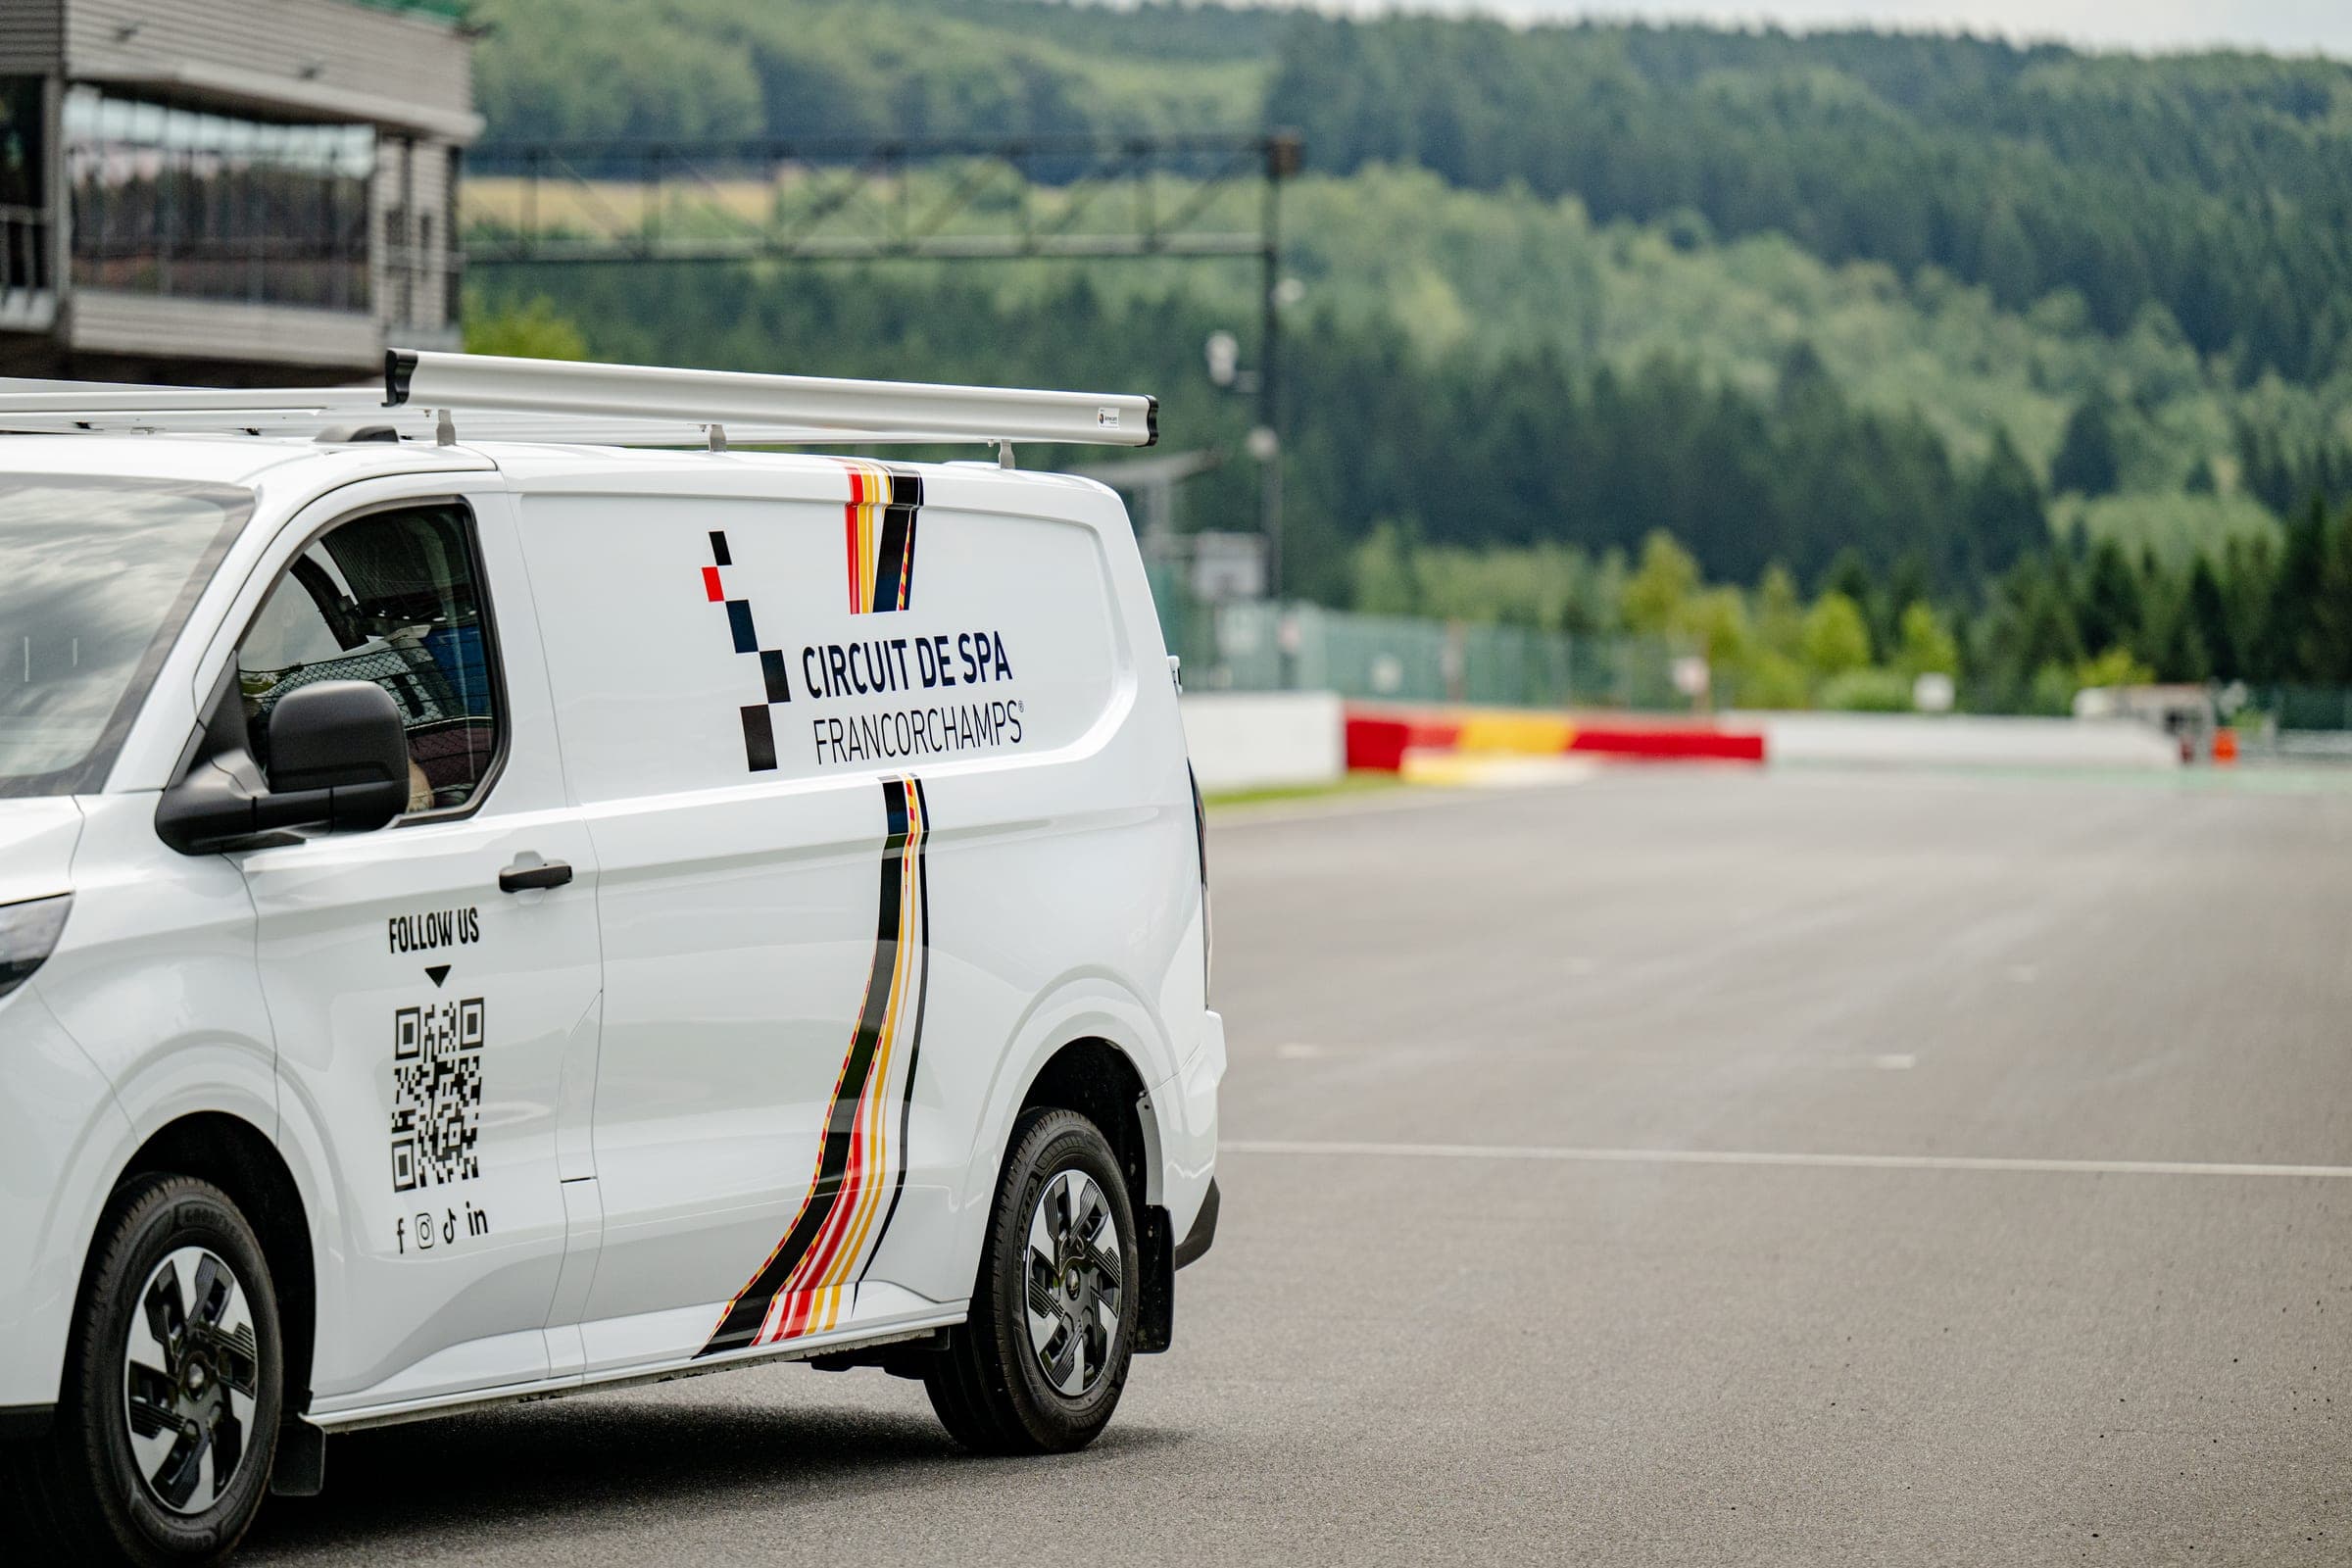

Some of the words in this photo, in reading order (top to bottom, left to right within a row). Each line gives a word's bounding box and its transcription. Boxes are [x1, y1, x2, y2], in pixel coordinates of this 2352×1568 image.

[802, 639, 909, 699] CIRCUIT
[915, 635, 956, 688] DE
[957, 631, 1013, 684] SPA
[389, 910, 453, 955] FOLLOW
[458, 906, 479, 945] US
[466, 1200, 488, 1237] in
